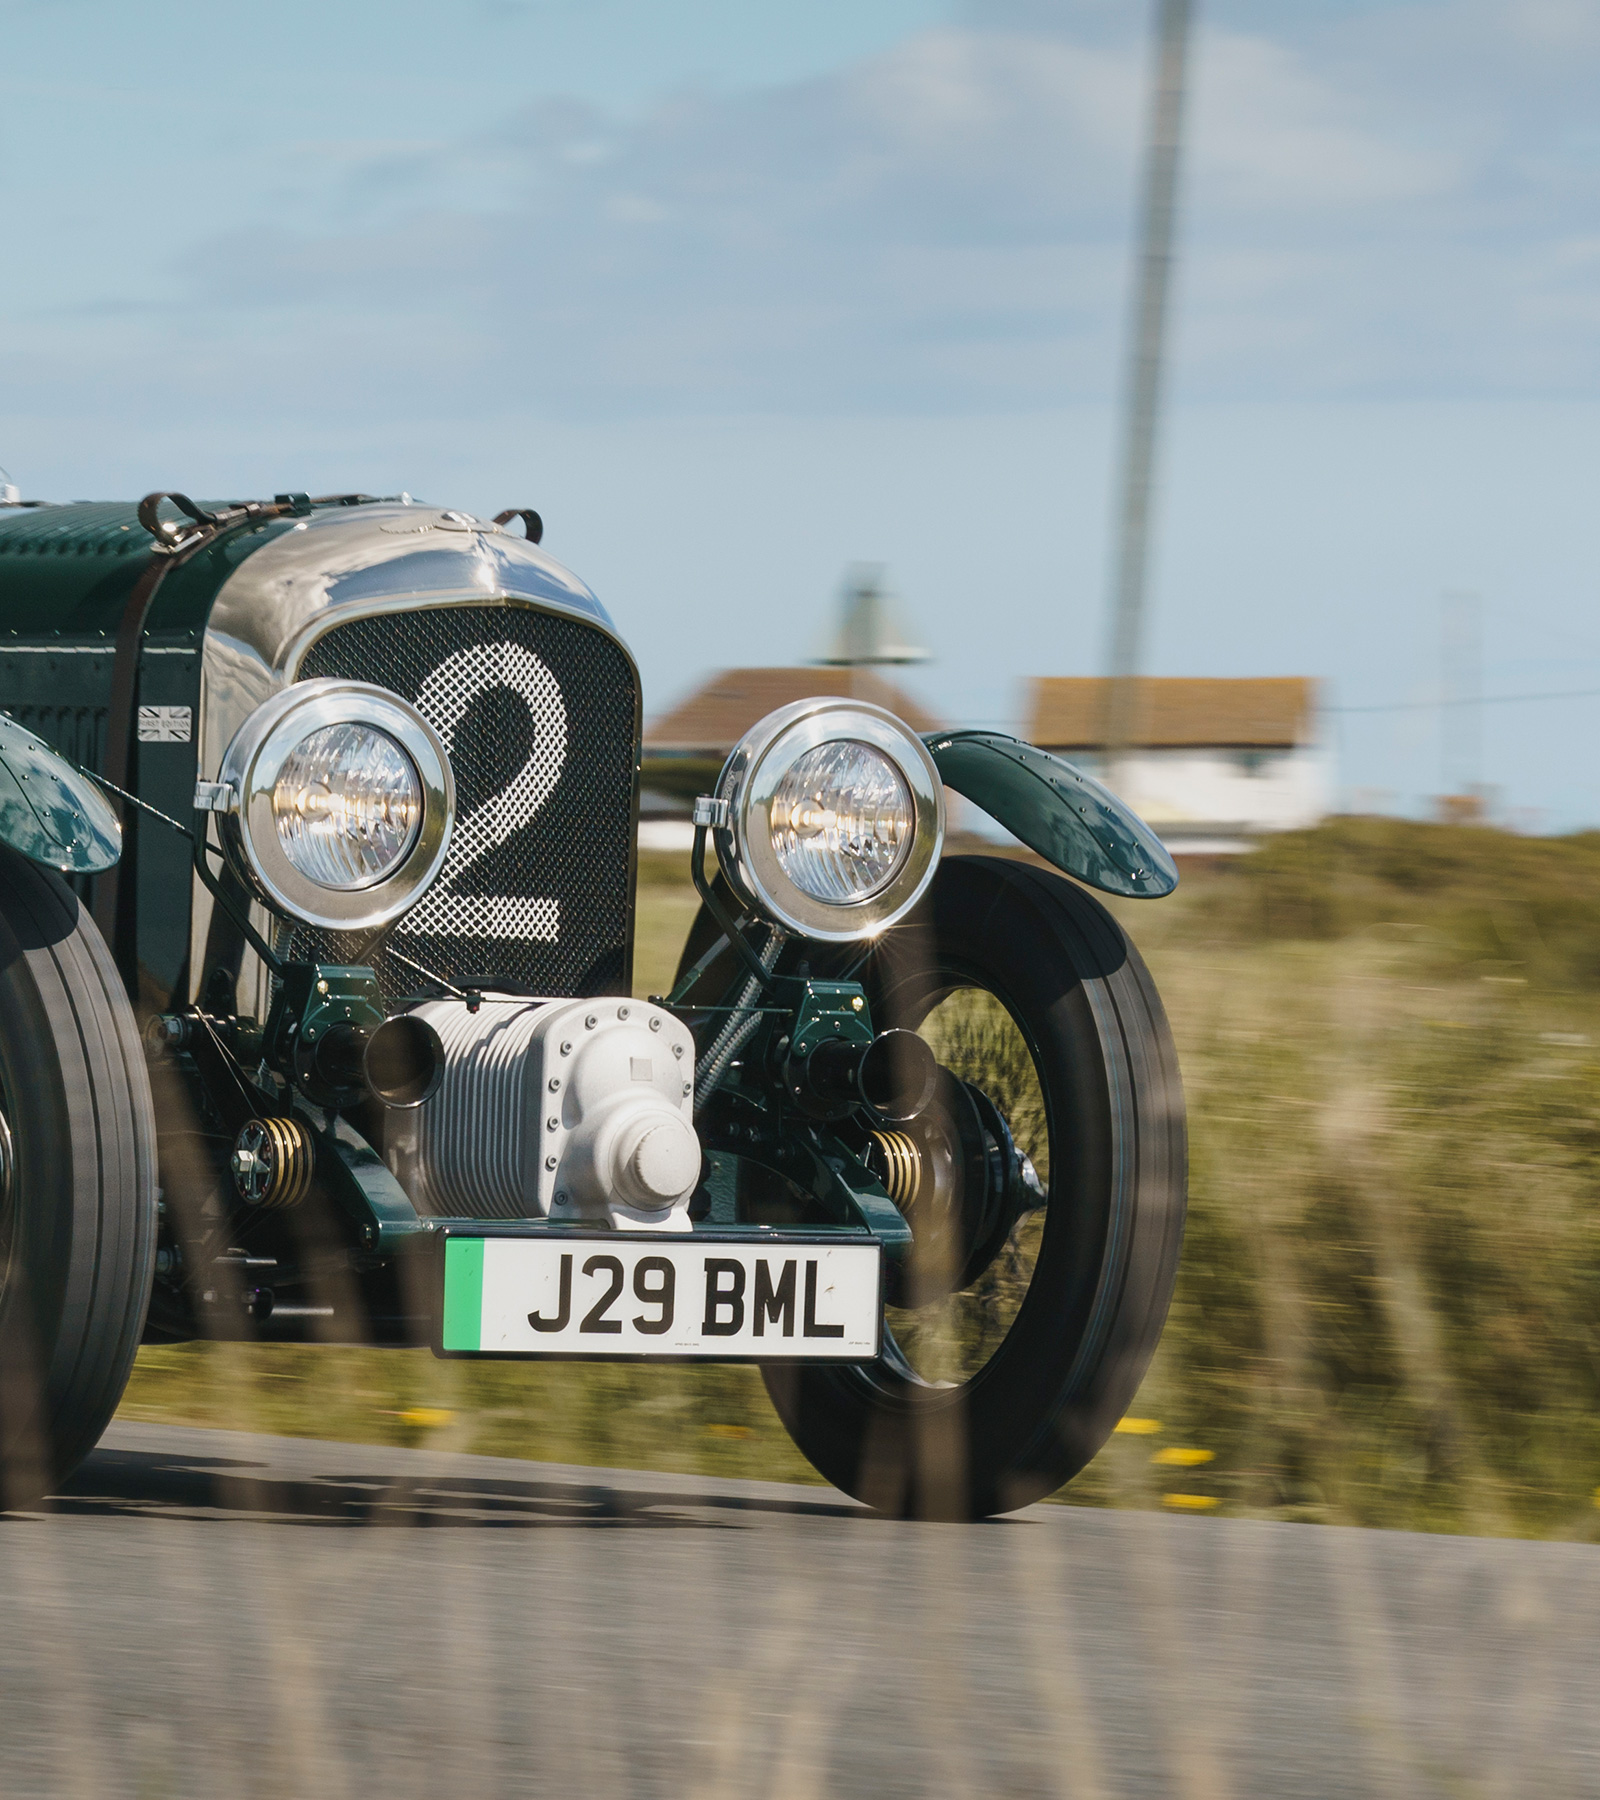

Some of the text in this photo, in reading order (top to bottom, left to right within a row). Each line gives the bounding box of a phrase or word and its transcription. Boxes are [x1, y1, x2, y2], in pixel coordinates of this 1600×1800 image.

[396, 641, 568, 942] 2
[527, 1254, 845, 1338] J29 BML
